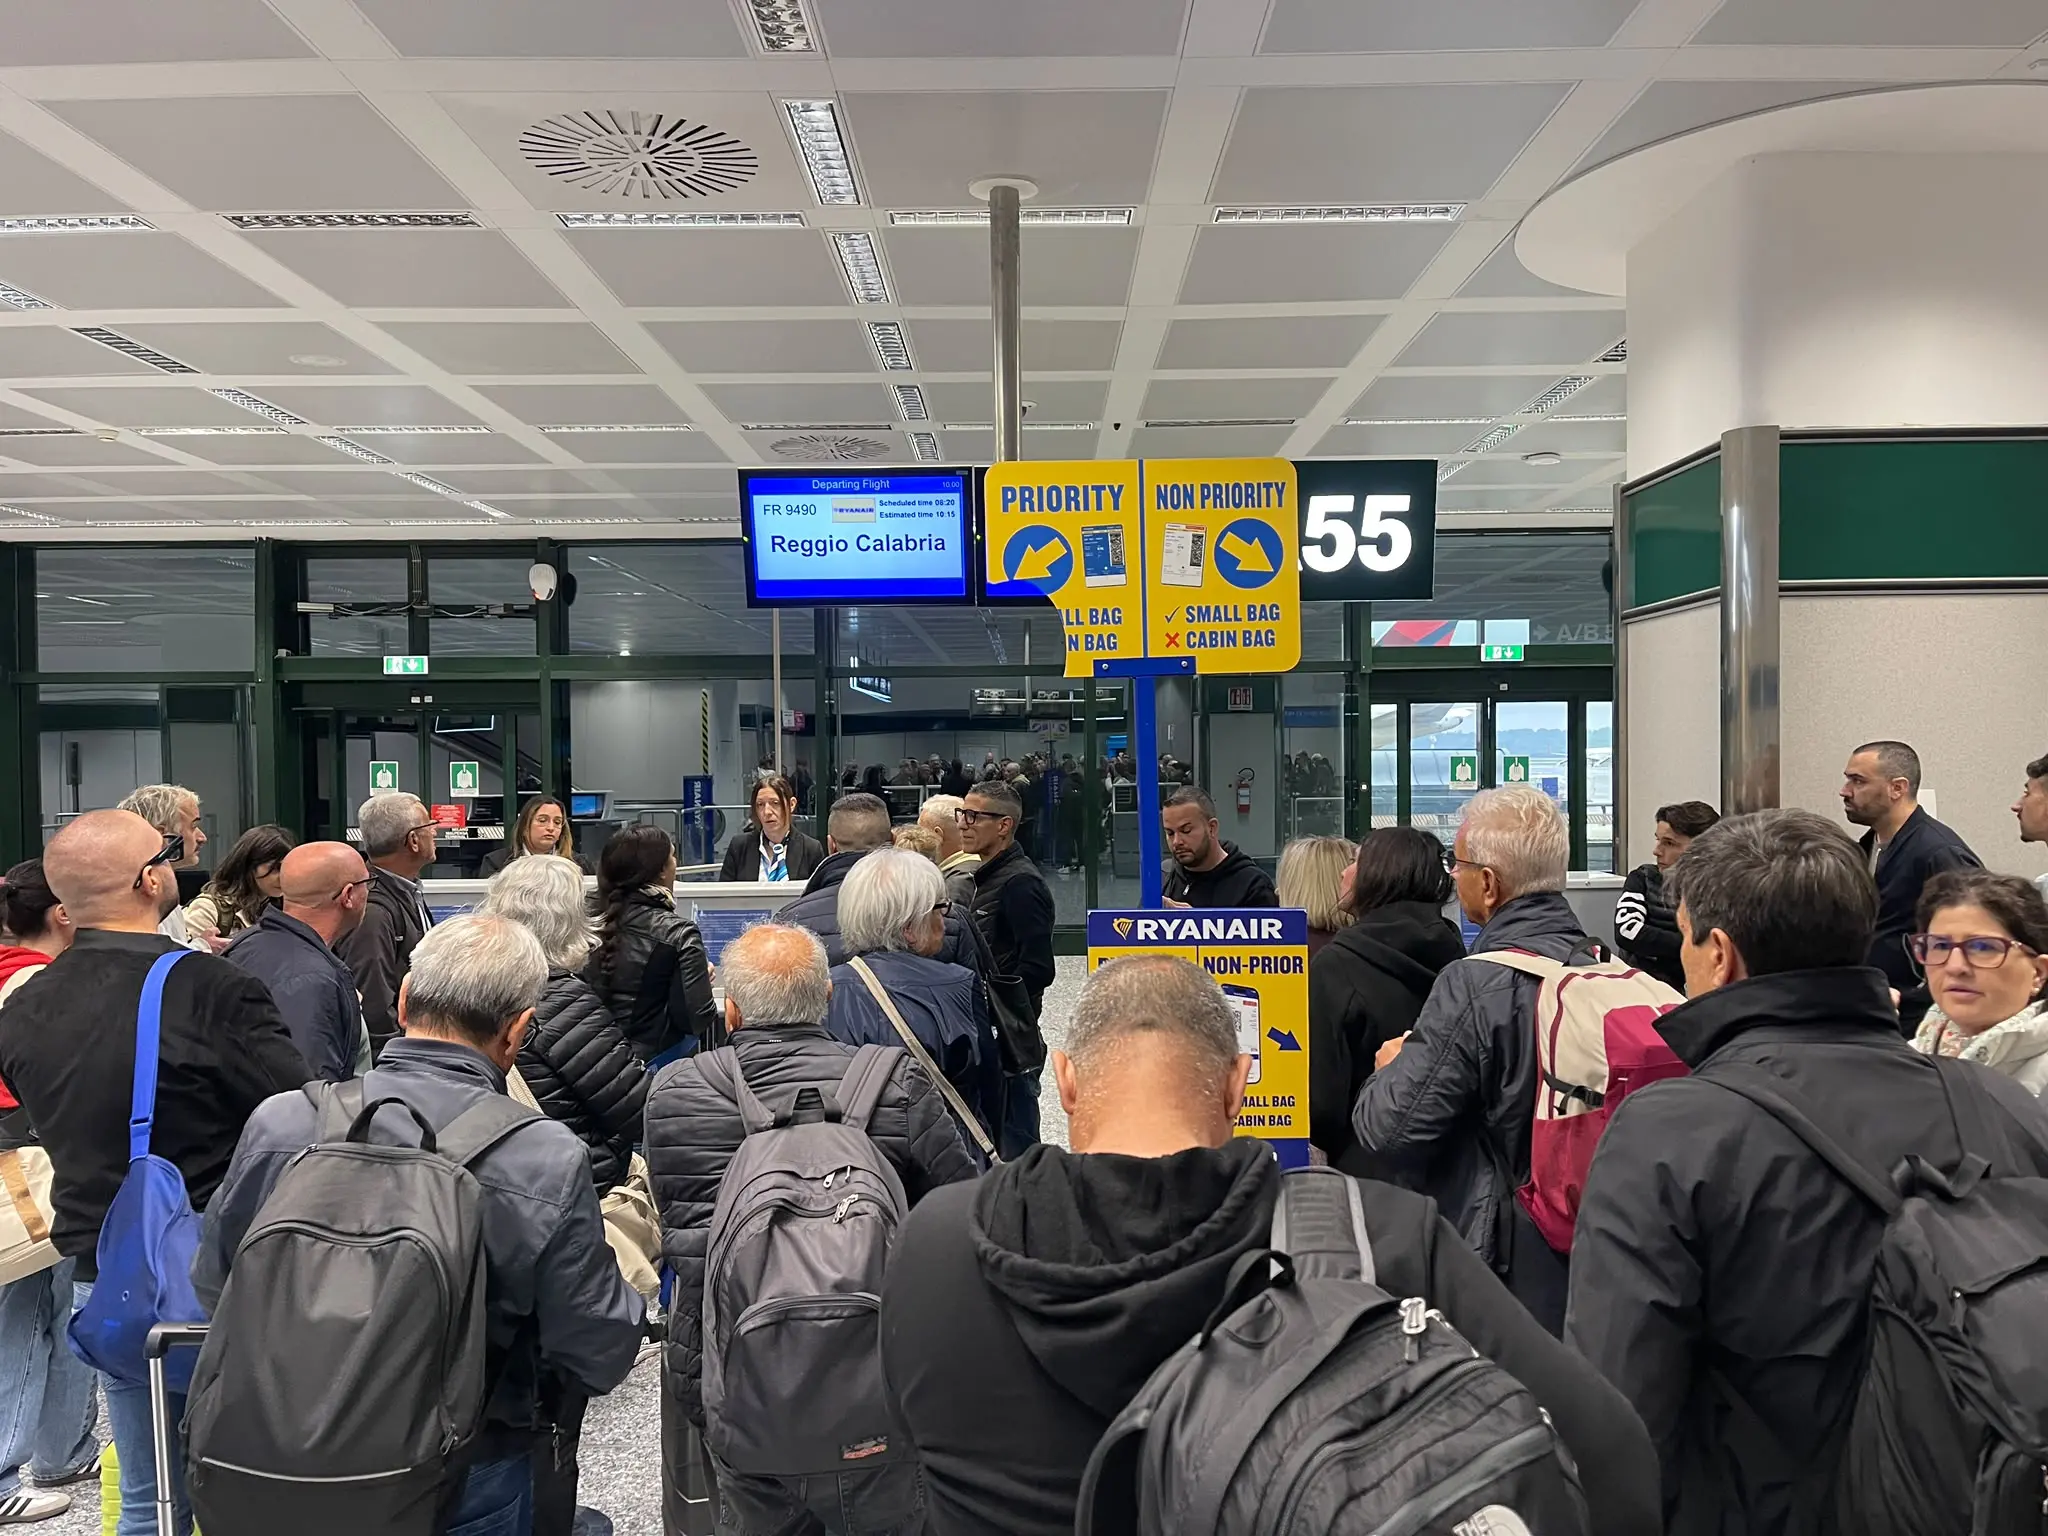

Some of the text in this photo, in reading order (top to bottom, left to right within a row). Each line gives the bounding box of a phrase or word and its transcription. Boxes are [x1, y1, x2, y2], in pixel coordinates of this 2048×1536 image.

[812, 479, 890, 490] Departing Flight
[1001, 484, 1124, 513] PRIORITY
[1156, 482, 1287, 510] NON PRIORITY
[763, 504, 817, 516] FR 9490
[1298, 494, 1412, 573] 55
[771, 534, 946, 557] Reggio Calabria
[1089, 607, 1122, 626] BAG
[1186, 603, 1280, 623] SMALL BAG
[1084, 632, 1118, 651] BAG
[1186, 629, 1276, 649] CABIN BAG
[1137, 918, 1283, 940] RYANAIR
[1204, 956, 1304, 974] NON-PRIOR
[1241, 1095, 1295, 1107] MALL BAG
[1269, 1114, 1292, 1126] BAG
